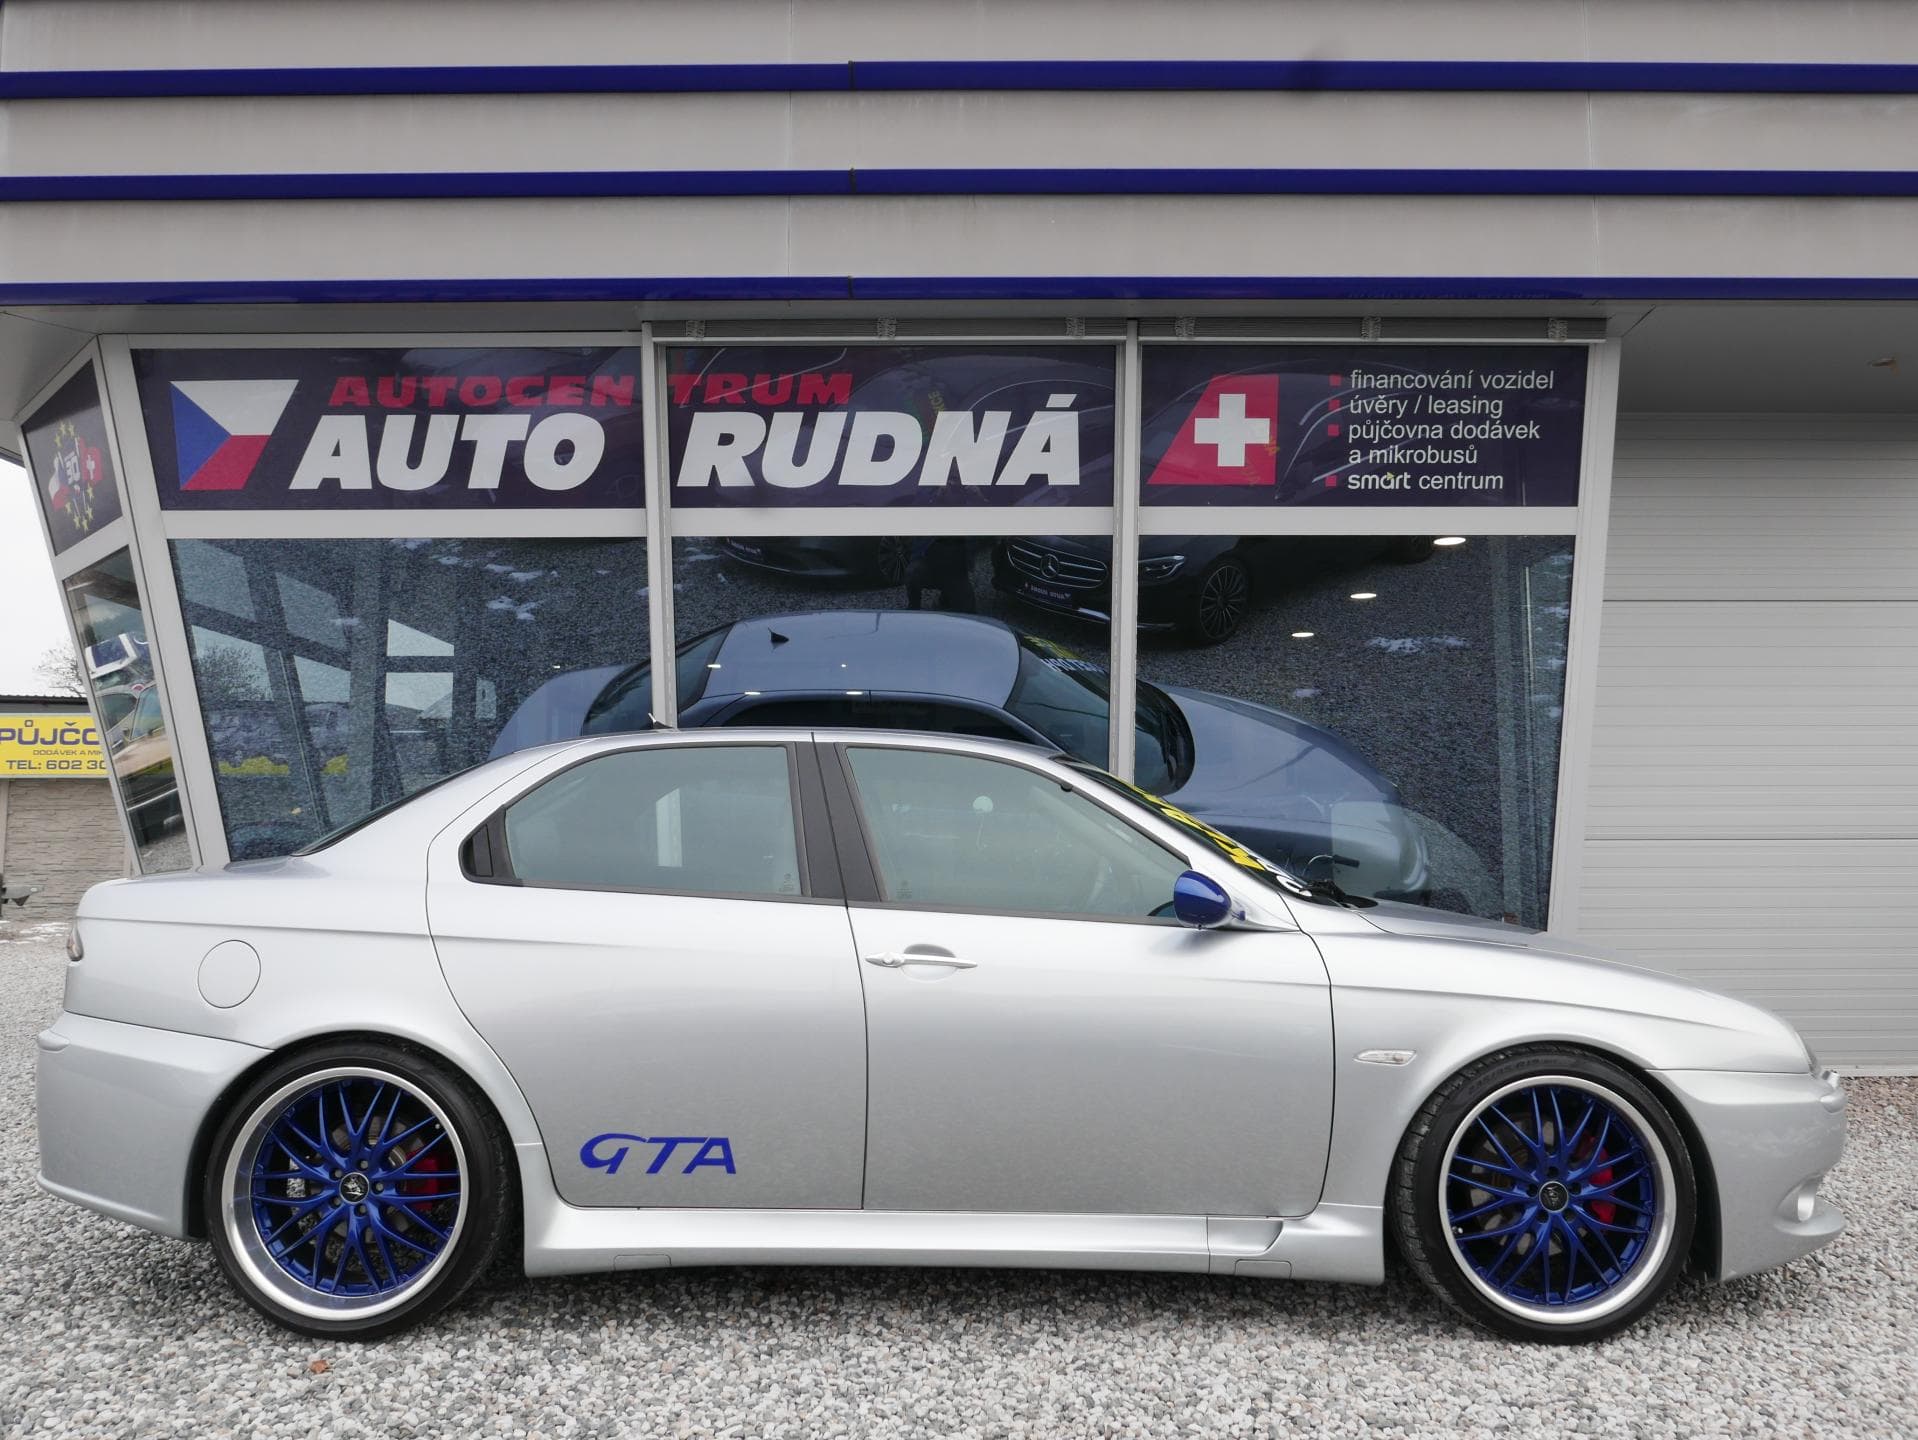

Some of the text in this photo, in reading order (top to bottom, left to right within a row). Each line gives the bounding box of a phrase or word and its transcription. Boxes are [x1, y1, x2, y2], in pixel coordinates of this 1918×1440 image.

[1350, 369, 1554, 390] financování vozidel
[1349, 395, 1503, 418] úvěry / leasing
[1348, 419, 1541, 443] půjčovna dodávek
[288, 393, 1081, 491] AUTO RUDNÁ
[1348, 445, 1478, 464] a mikrobusů
[1347, 471, 1504, 490] smart centrum
[33, 748, 77, 756] DODÁVEK
[6, 759, 42, 770] TEL:
[46, 759, 82, 770] 602
[580, 1133, 737, 1174] GTA
